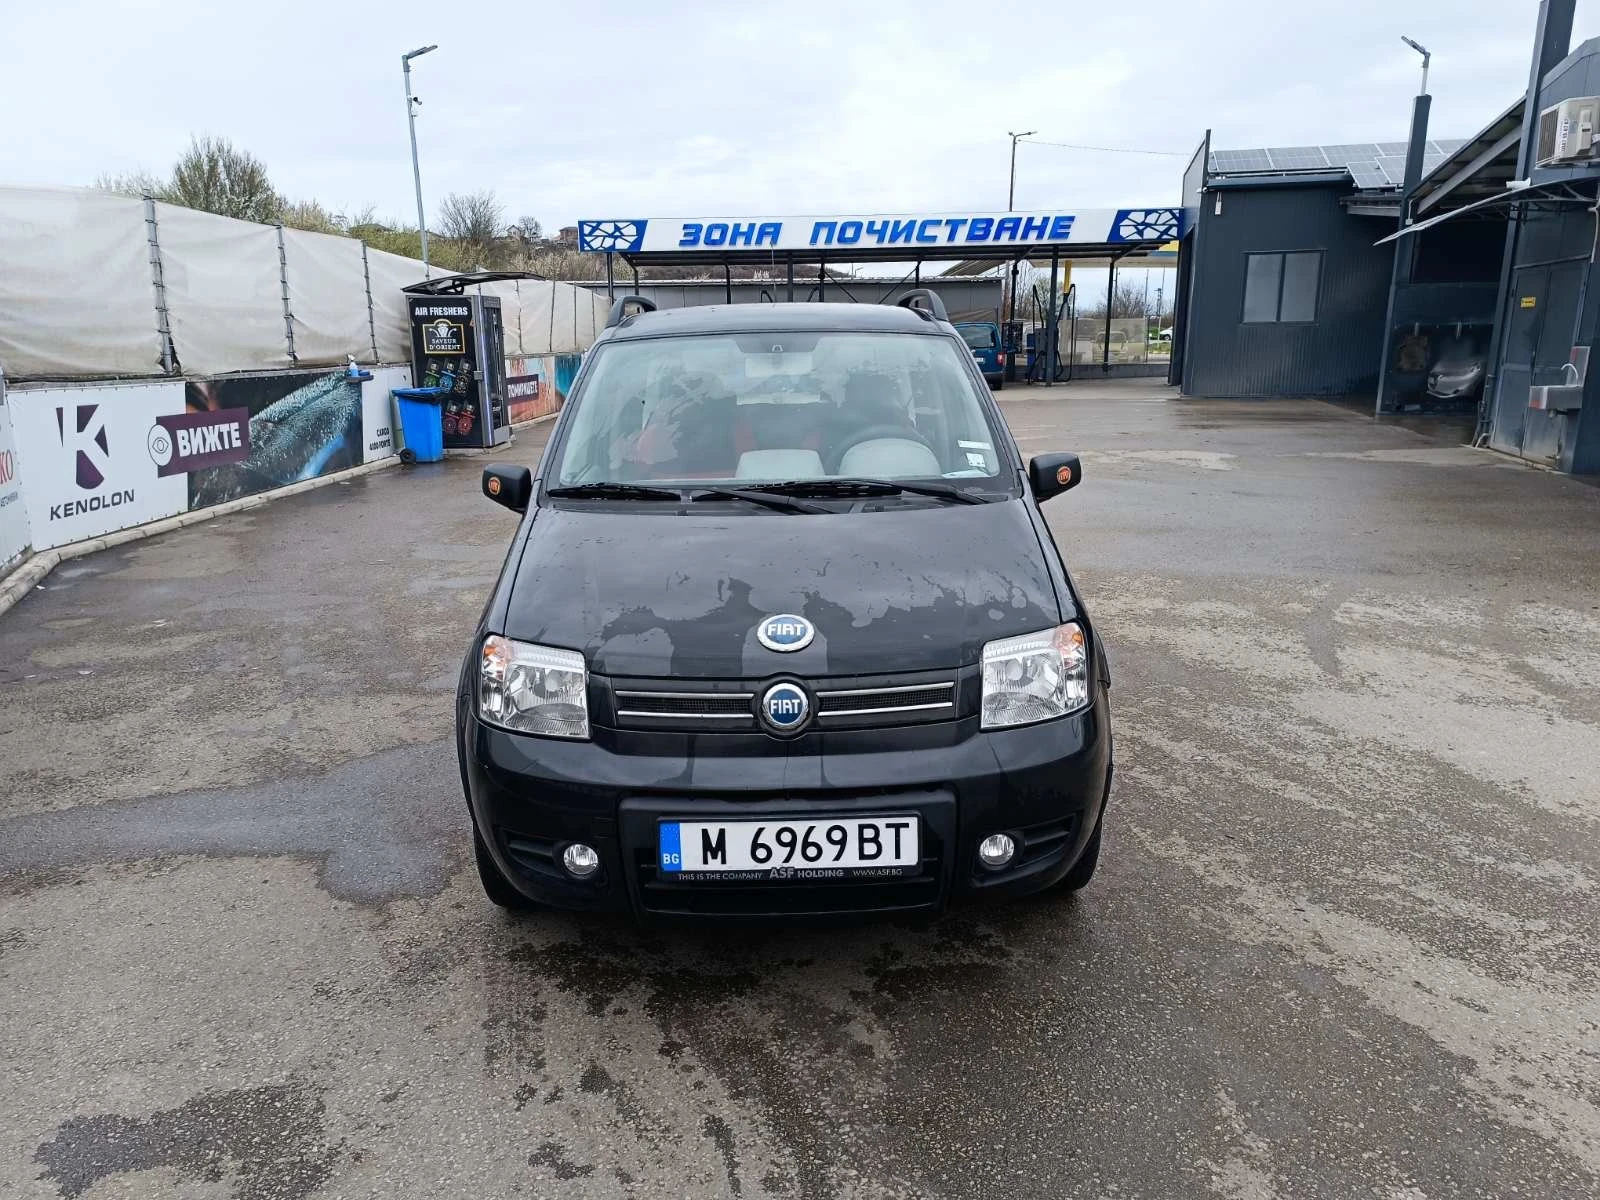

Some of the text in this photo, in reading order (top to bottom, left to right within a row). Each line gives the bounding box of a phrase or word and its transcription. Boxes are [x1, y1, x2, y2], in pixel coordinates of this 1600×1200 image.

[678, 215, 1076, 246] ЗОНА ПОЧИСТВАНЕ
[415, 307, 468, 316] AIR FRESHERS
[176, 421, 242, 457] ВИЖТЕ
[50, 489, 135, 521] KENOLON
[767, 623, 804, 636] FIAT
[770, 699, 801, 714] FIAT
[701, 827, 727, 865] M
[662, 853, 680, 865] BG
[722, 872, 762, 880] COMPANY
[769, 867, 795, 879] ASF
[797, 869, 845, 878] HOLDING
[852, 868, 903, 877] WWW.ASF.BG
